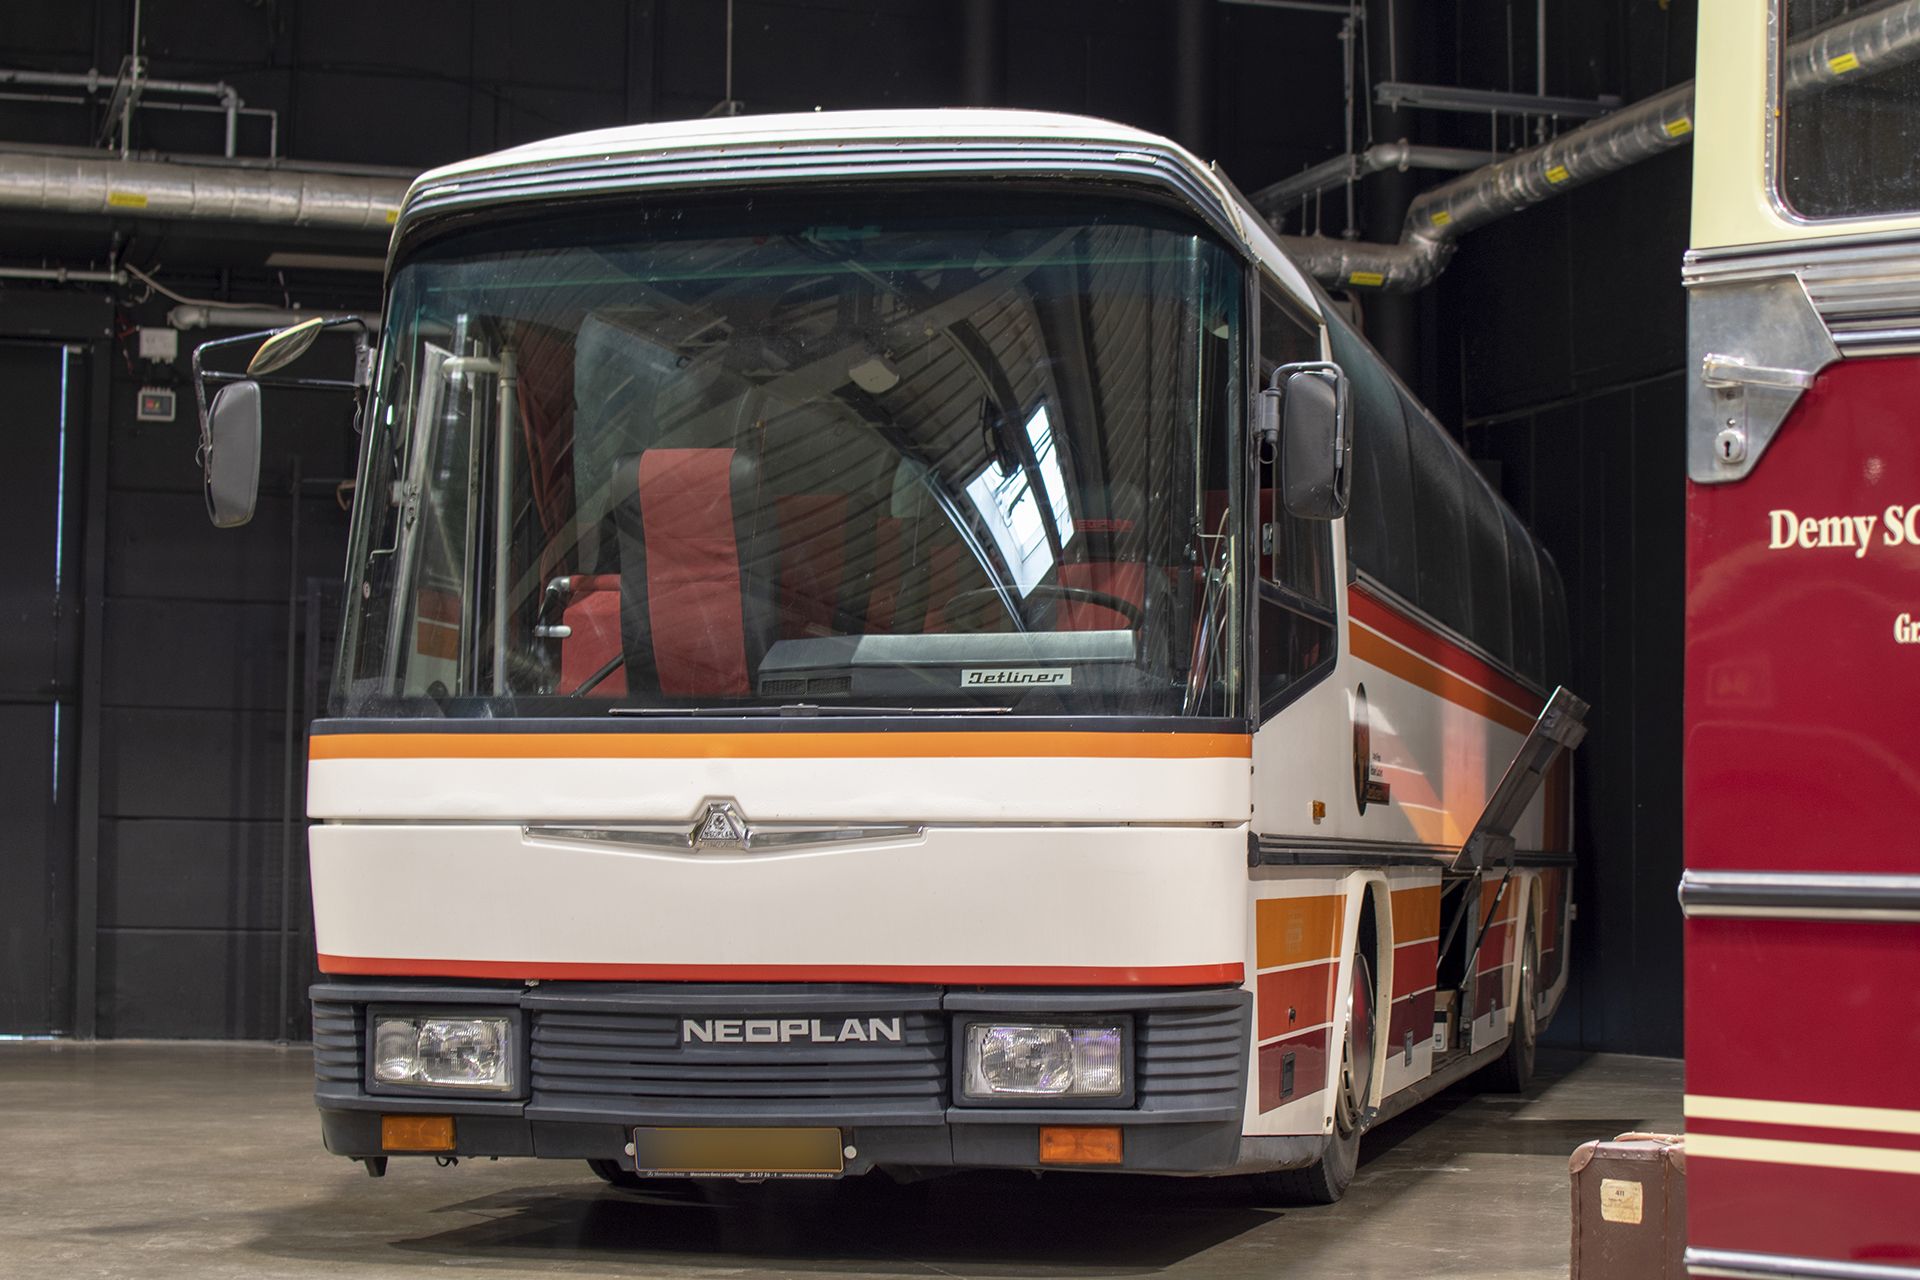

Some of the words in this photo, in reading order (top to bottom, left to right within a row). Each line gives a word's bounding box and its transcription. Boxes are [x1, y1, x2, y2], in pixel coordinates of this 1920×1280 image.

[1768, 509, 1877, 558] Demy
[1893, 612, 1920, 644] Gr
[968, 671, 1064, 684] Jetliner
[683, 1017, 901, 1043] NEOPLAN
